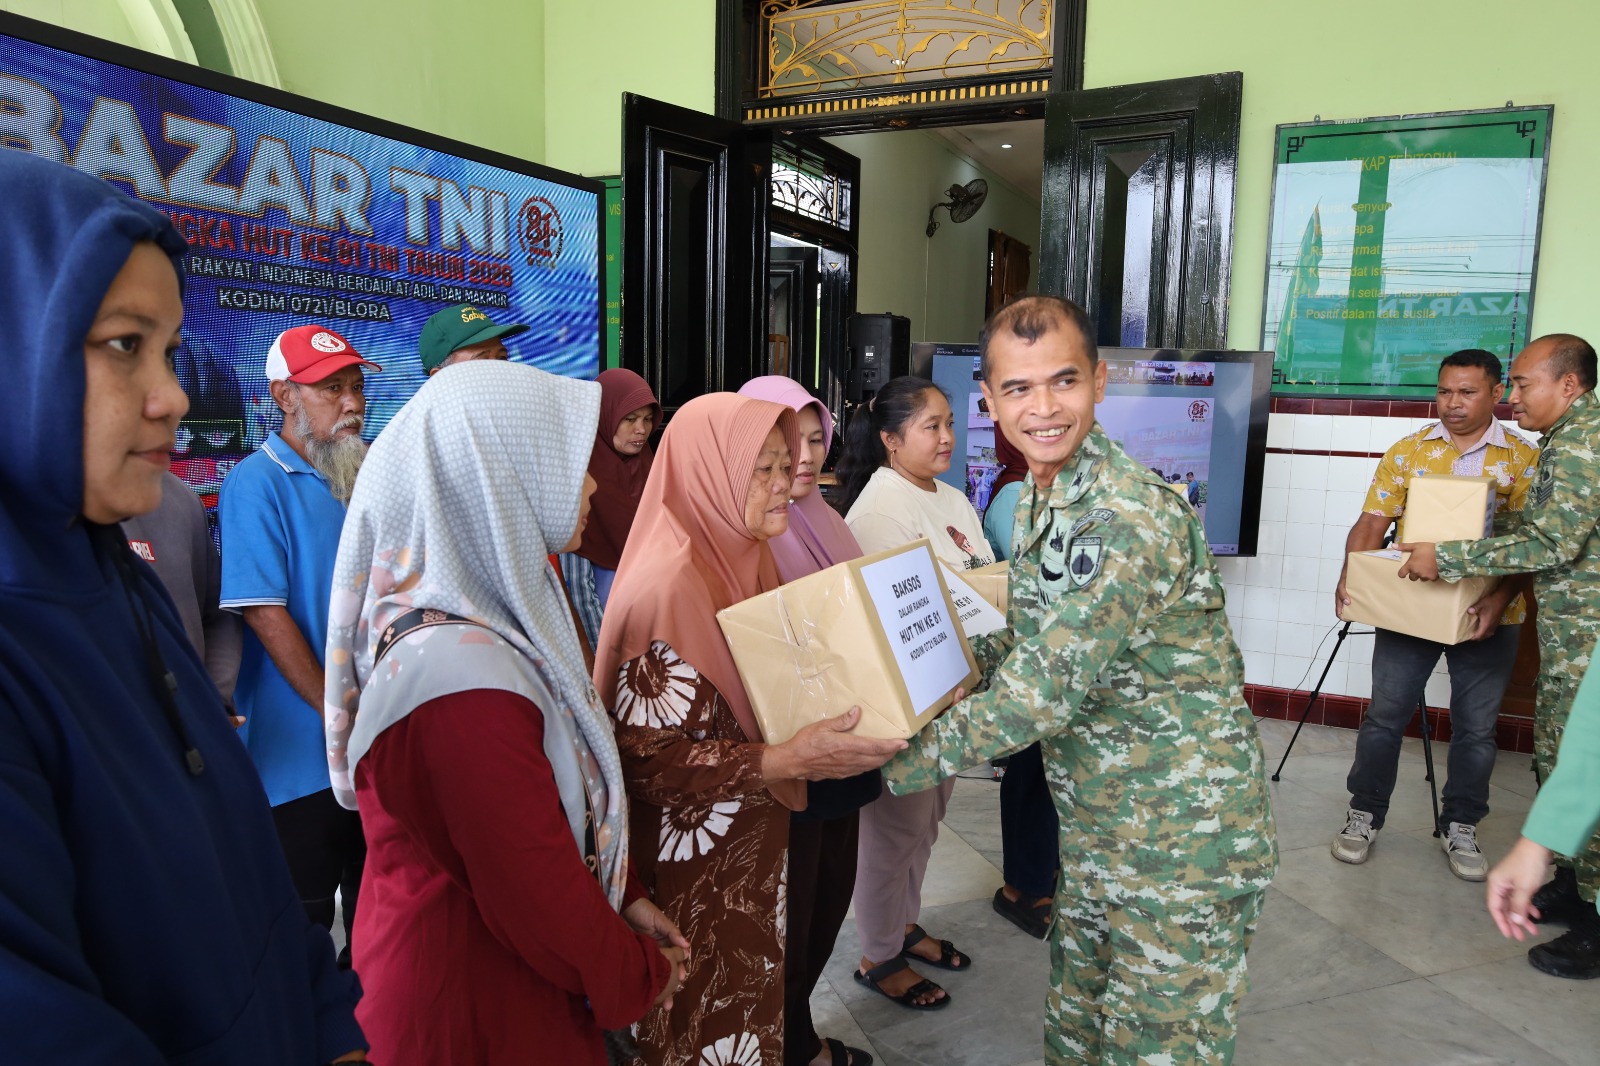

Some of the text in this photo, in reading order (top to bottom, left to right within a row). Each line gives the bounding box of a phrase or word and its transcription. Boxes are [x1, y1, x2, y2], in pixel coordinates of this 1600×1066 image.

[1351, 156, 1385, 171] SIKAP
[389, 166, 510, 259] TNI
[243, 223, 293, 257] HUT
[301, 232, 331, 262] KE
[337, 239, 360, 267] 81
[365, 243, 399, 272] TNI
[404, 248, 464, 280] TAHUN
[469, 258, 513, 287] 2026
[260, 264, 335, 288] INDONESIA
[338, 274, 409, 296] BERDAULAT
[413, 282, 438, 299] ADIL
[441, 286, 462, 301] DAN
[464, 289, 507, 306] MAKMUR
[219, 288, 390, 320] KODIM 0721/BLORA
[1342, 308, 1375, 319] dalam
[128, 541, 155, 561] RVEL
[892, 574, 922, 599] BAKSOS
[898, 596, 930, 619] DALAM RANGKA
[953, 595, 973, 609] KE 81
[899, 610, 942, 645] HUT TNI KE 81
[909, 645, 925, 661] KODIM
